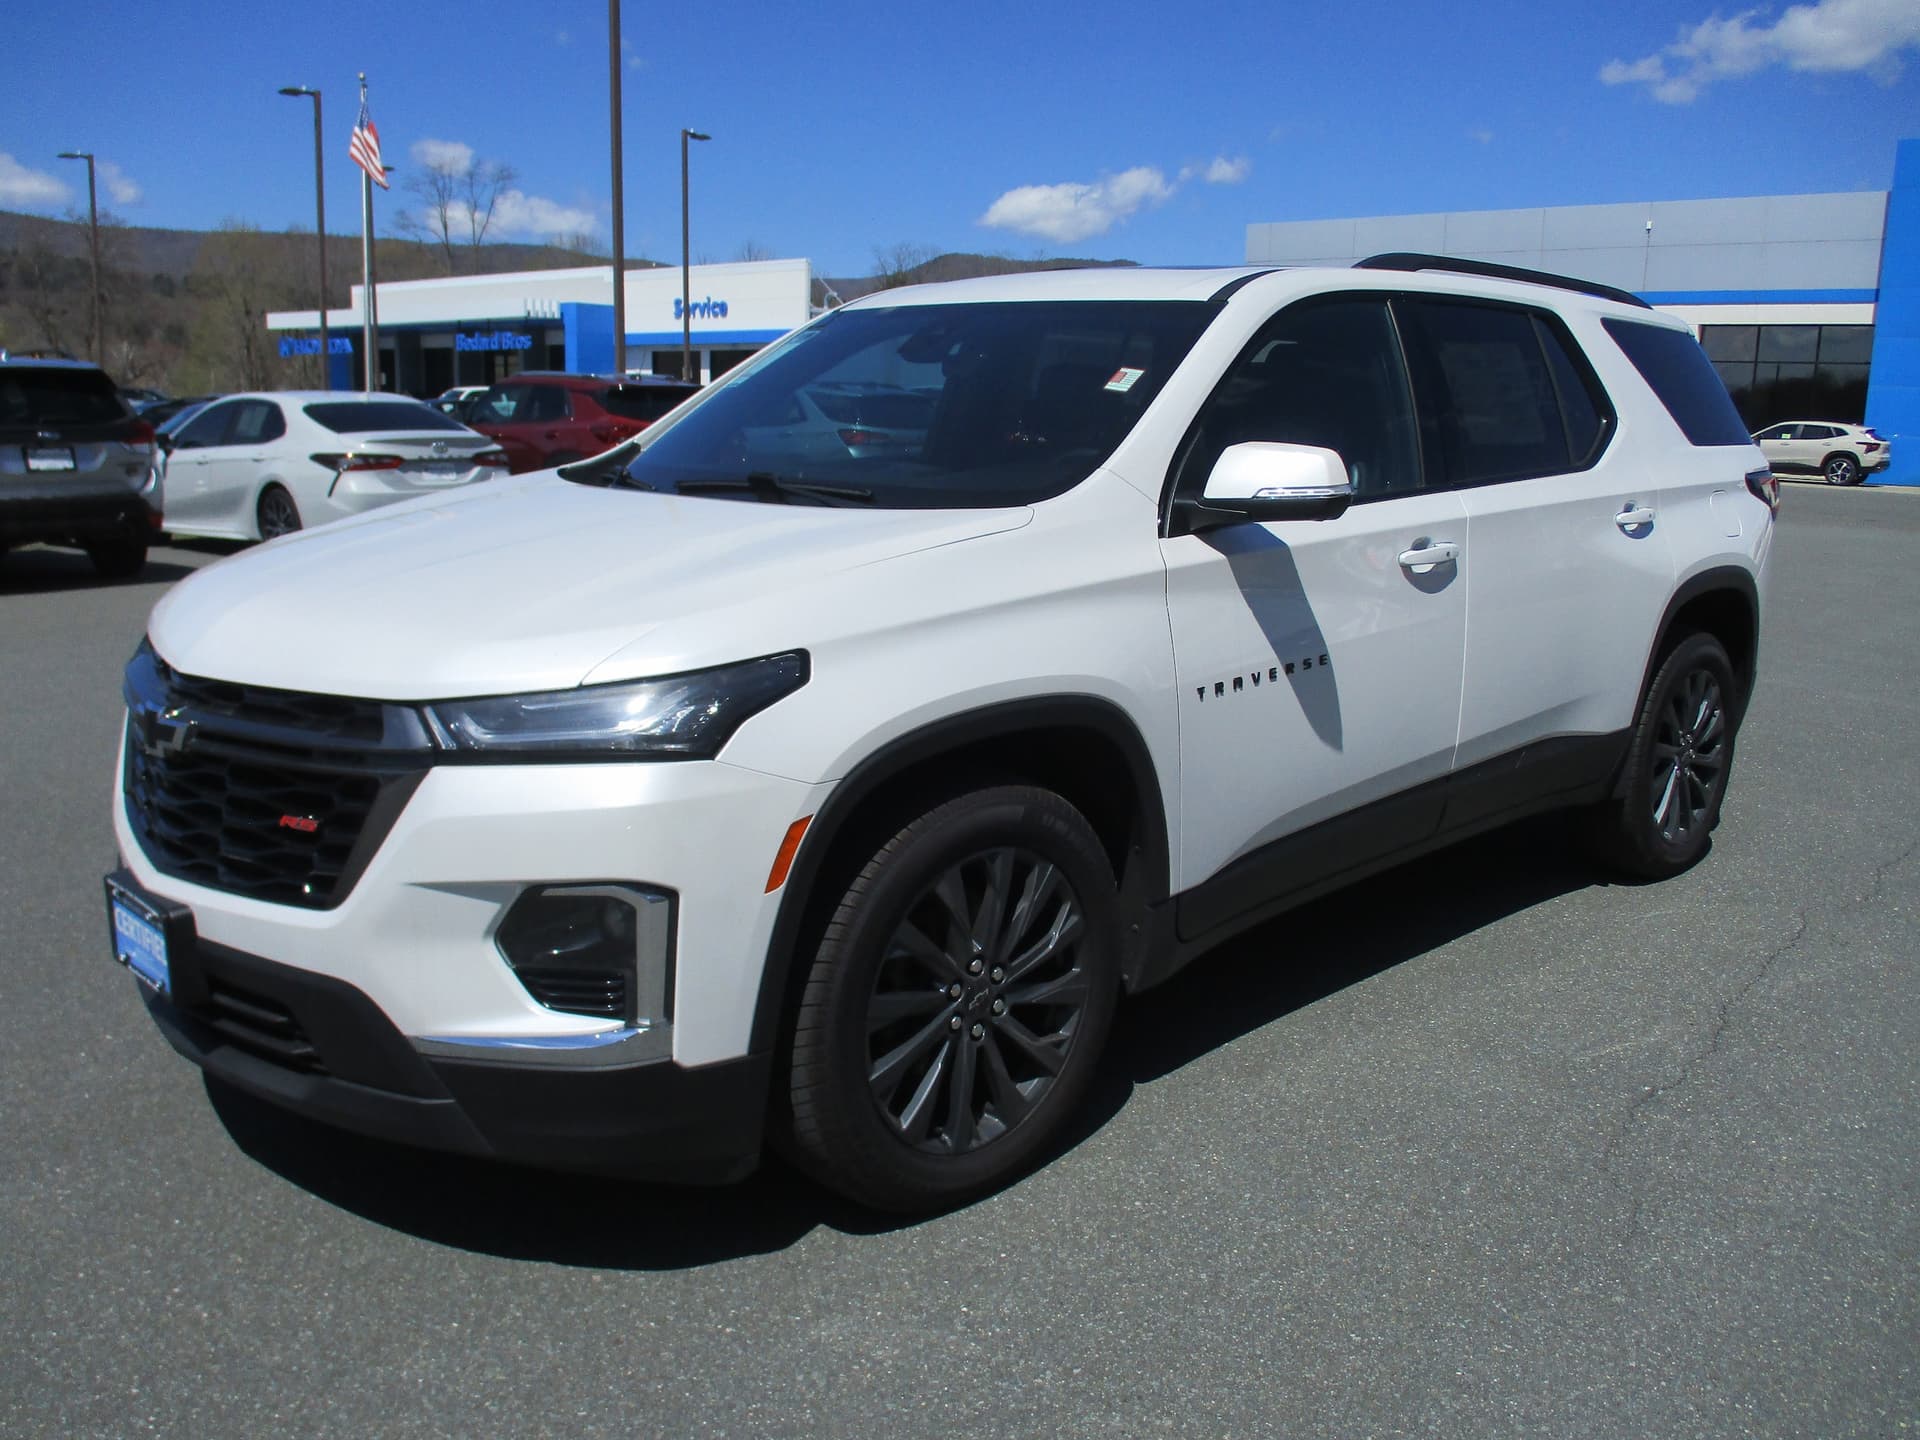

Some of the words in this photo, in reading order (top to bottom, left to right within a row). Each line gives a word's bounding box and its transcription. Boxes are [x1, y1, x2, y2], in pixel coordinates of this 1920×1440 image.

[673, 295, 728, 320] Srvice
[1196, 653, 1328, 702] TRAVERSE
[279, 815, 318, 832] RS
